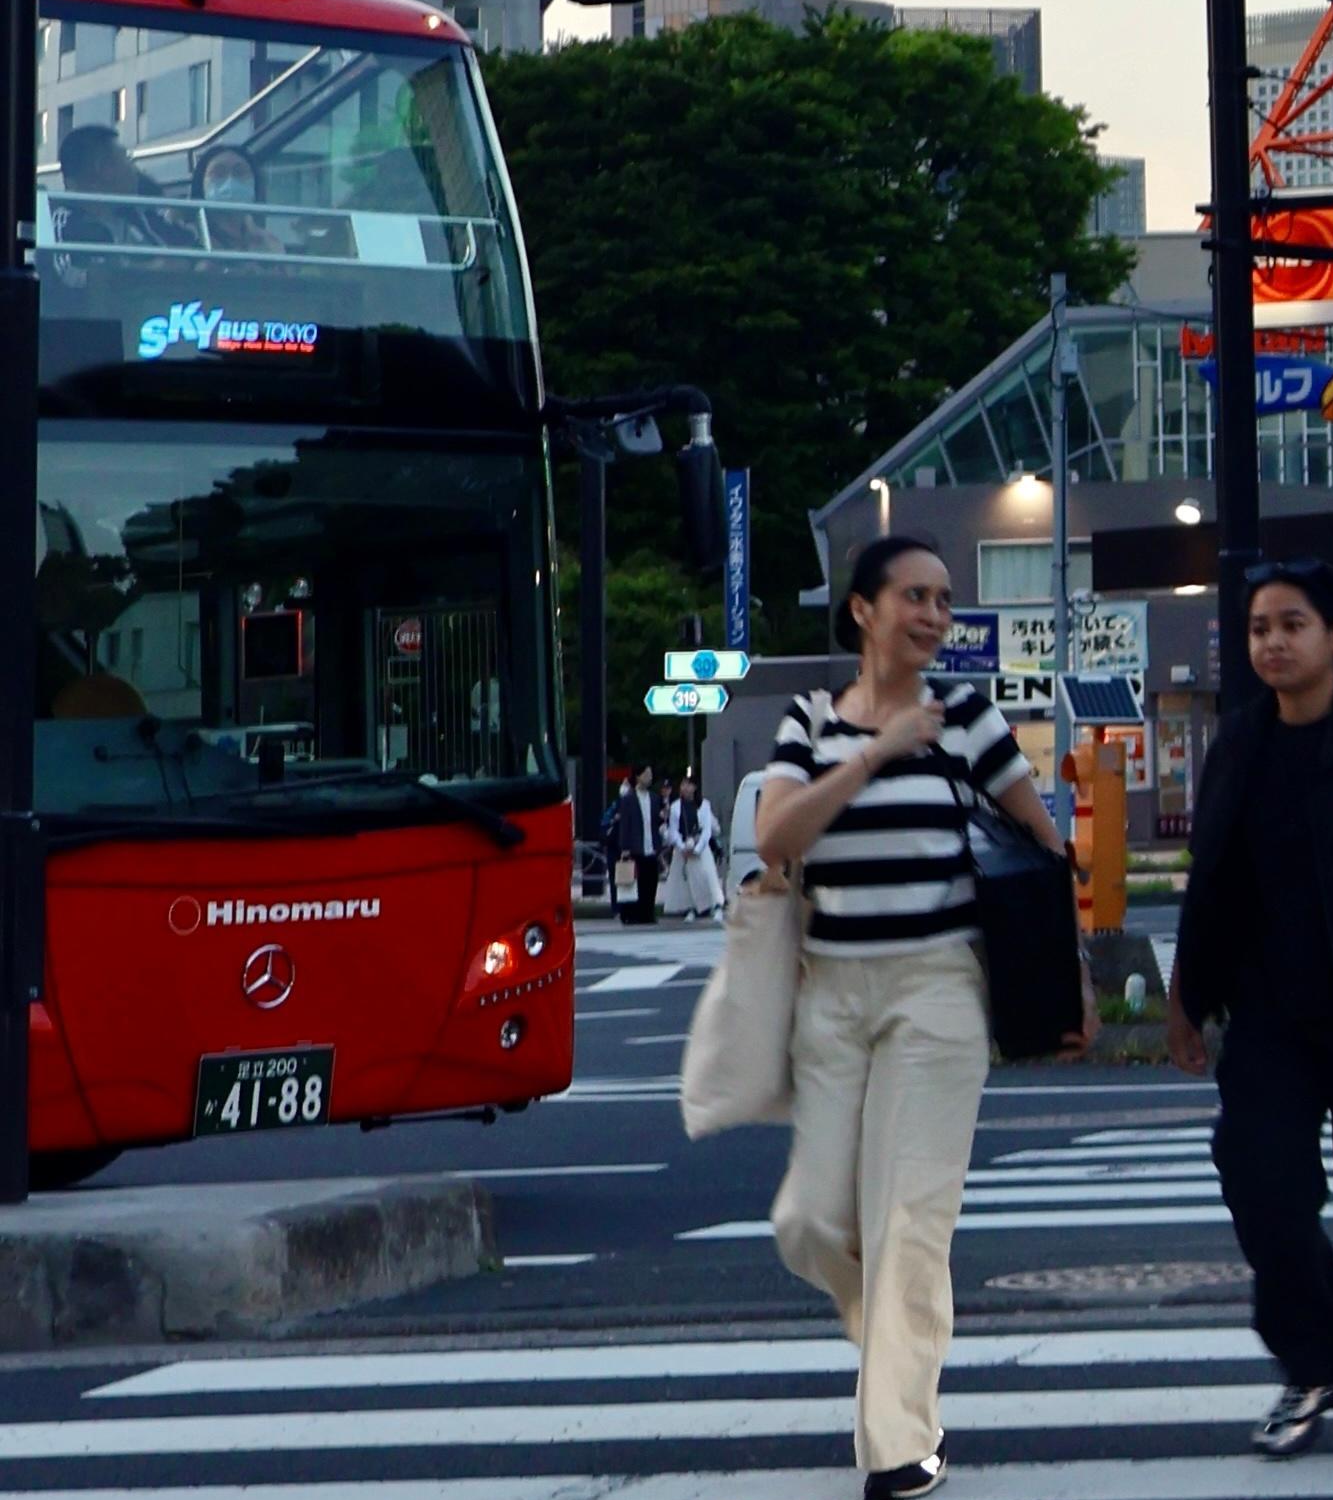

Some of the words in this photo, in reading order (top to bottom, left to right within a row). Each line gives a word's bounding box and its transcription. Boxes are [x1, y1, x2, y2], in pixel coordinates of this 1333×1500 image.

[138, 299, 224, 359] SKY
[217, 320, 259, 342] BUS
[263, 321, 318, 345] TOKYO
[1255, 367, 1313, 405] ルフ
[675, 691, 698, 707] 319
[206, 898, 381, 927] Hinomaru
[220, 1073, 323, 1129] 41-88
